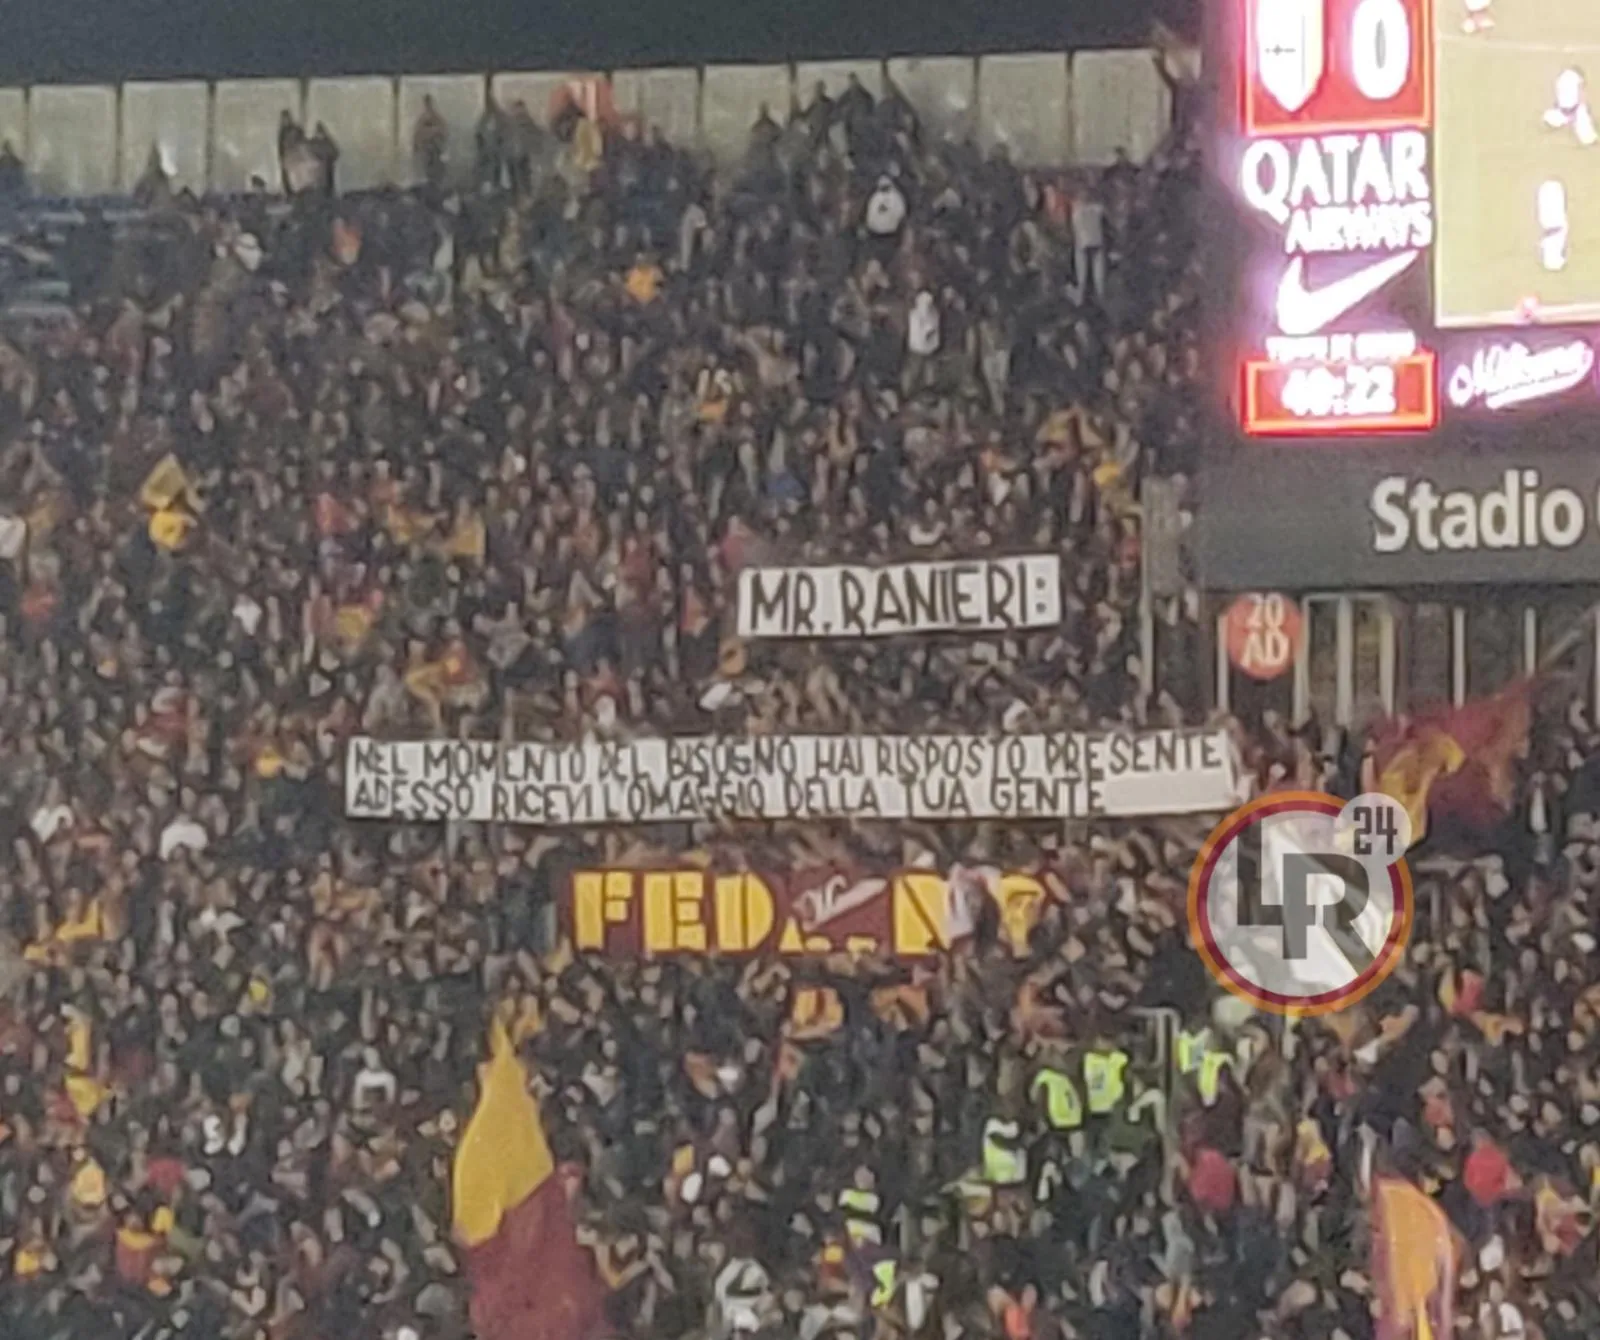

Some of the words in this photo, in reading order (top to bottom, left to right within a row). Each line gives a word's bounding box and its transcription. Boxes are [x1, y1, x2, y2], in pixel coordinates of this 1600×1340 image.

[1242, 131, 1430, 224] QATAR
[1371, 468, 1585, 551] Stadio
[354, 740, 408, 776] NEL
[423, 742, 586, 783] MOMENTO
[876, 737, 1027, 778] RISPOSTO
[1045, 732, 1222, 777] PRESENTE
[353, 777, 474, 819] ADESSO
[902, 774, 973, 818] TUA
[990, 776, 1105, 818] GENTE
